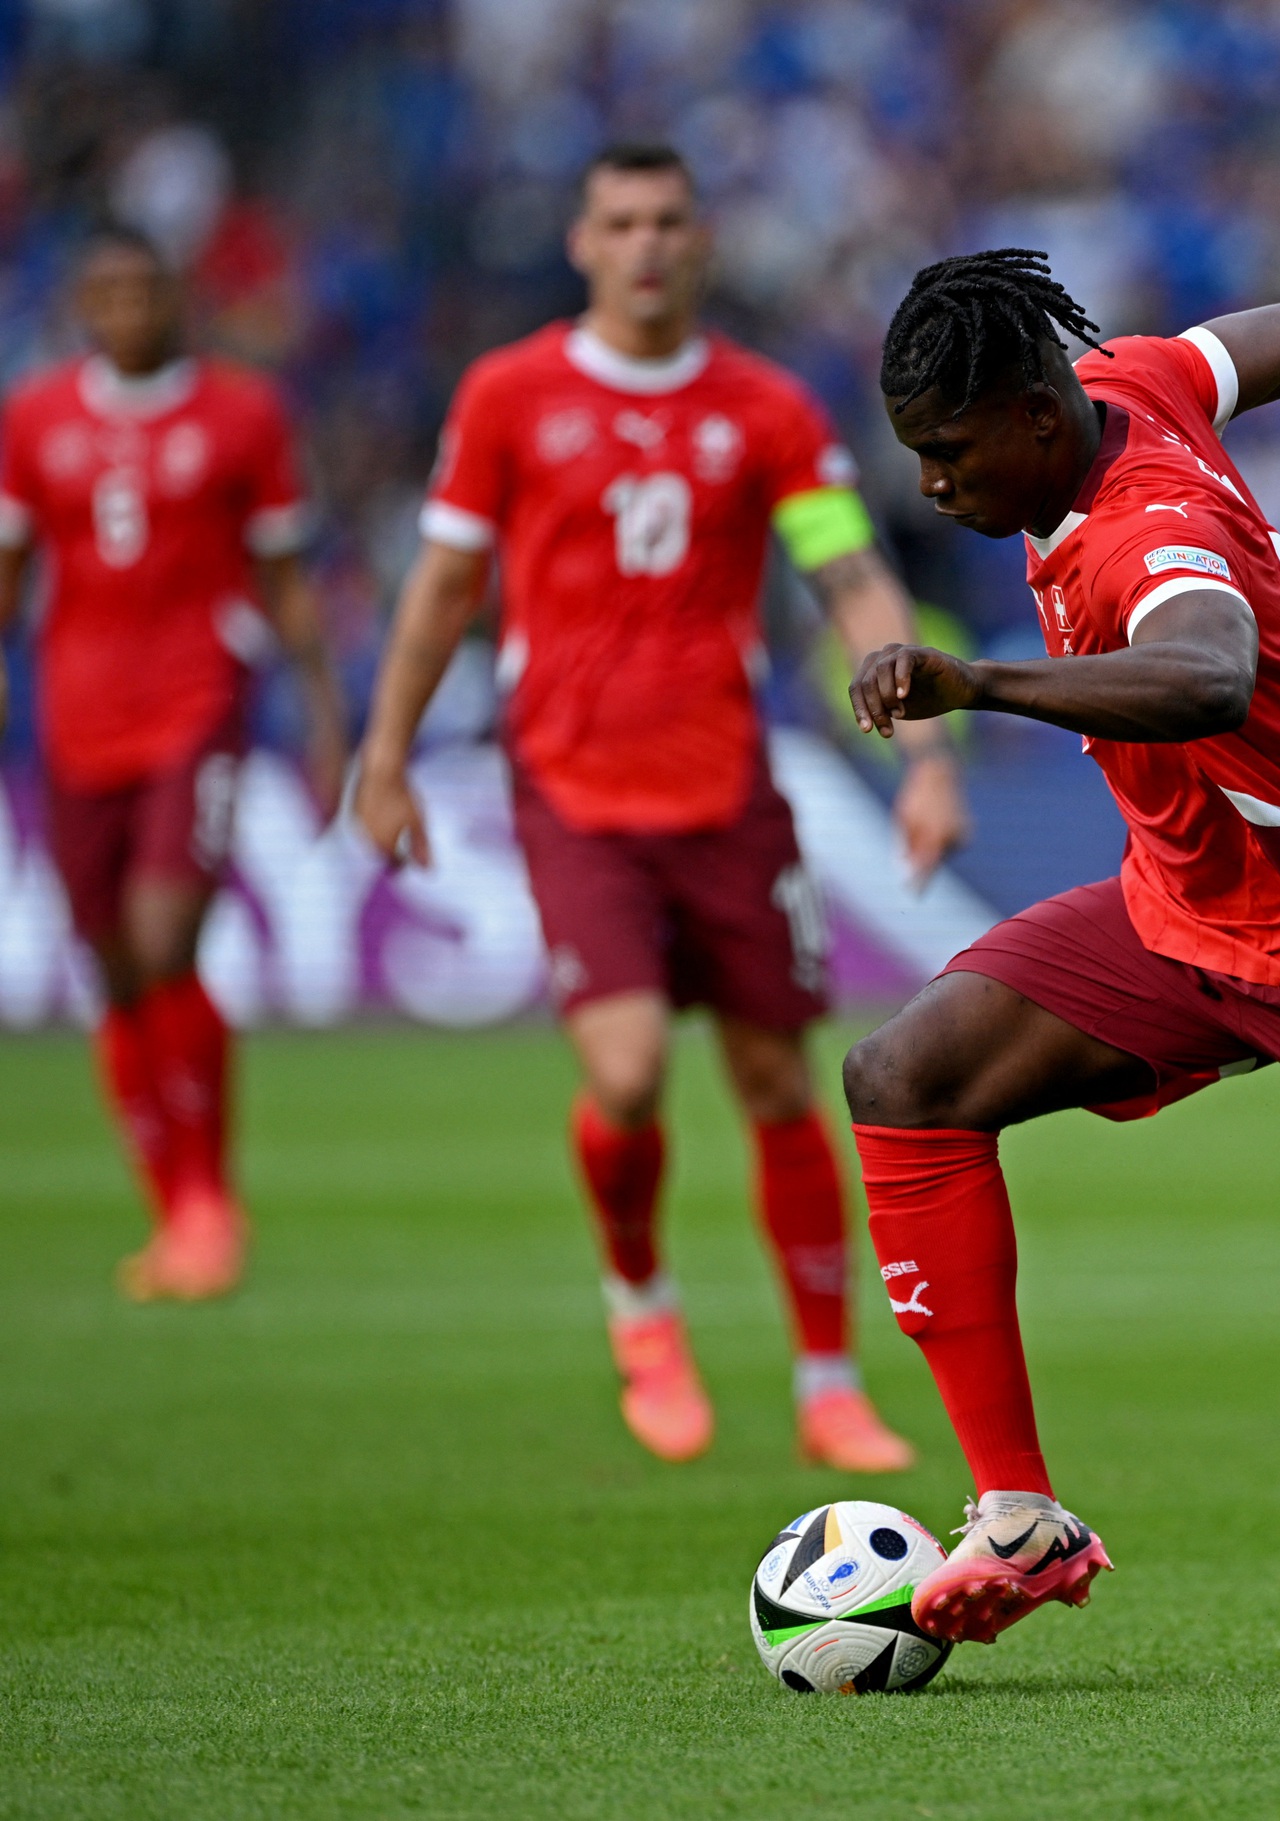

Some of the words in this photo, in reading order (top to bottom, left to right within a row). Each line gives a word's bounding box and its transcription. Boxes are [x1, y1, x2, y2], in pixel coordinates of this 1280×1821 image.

[601, 471, 693, 578] 10
[1146, 548, 1166, 561] UEFA
[803, 1571, 821, 1594] EURO
[816, 1593, 833, 1611] 2024
